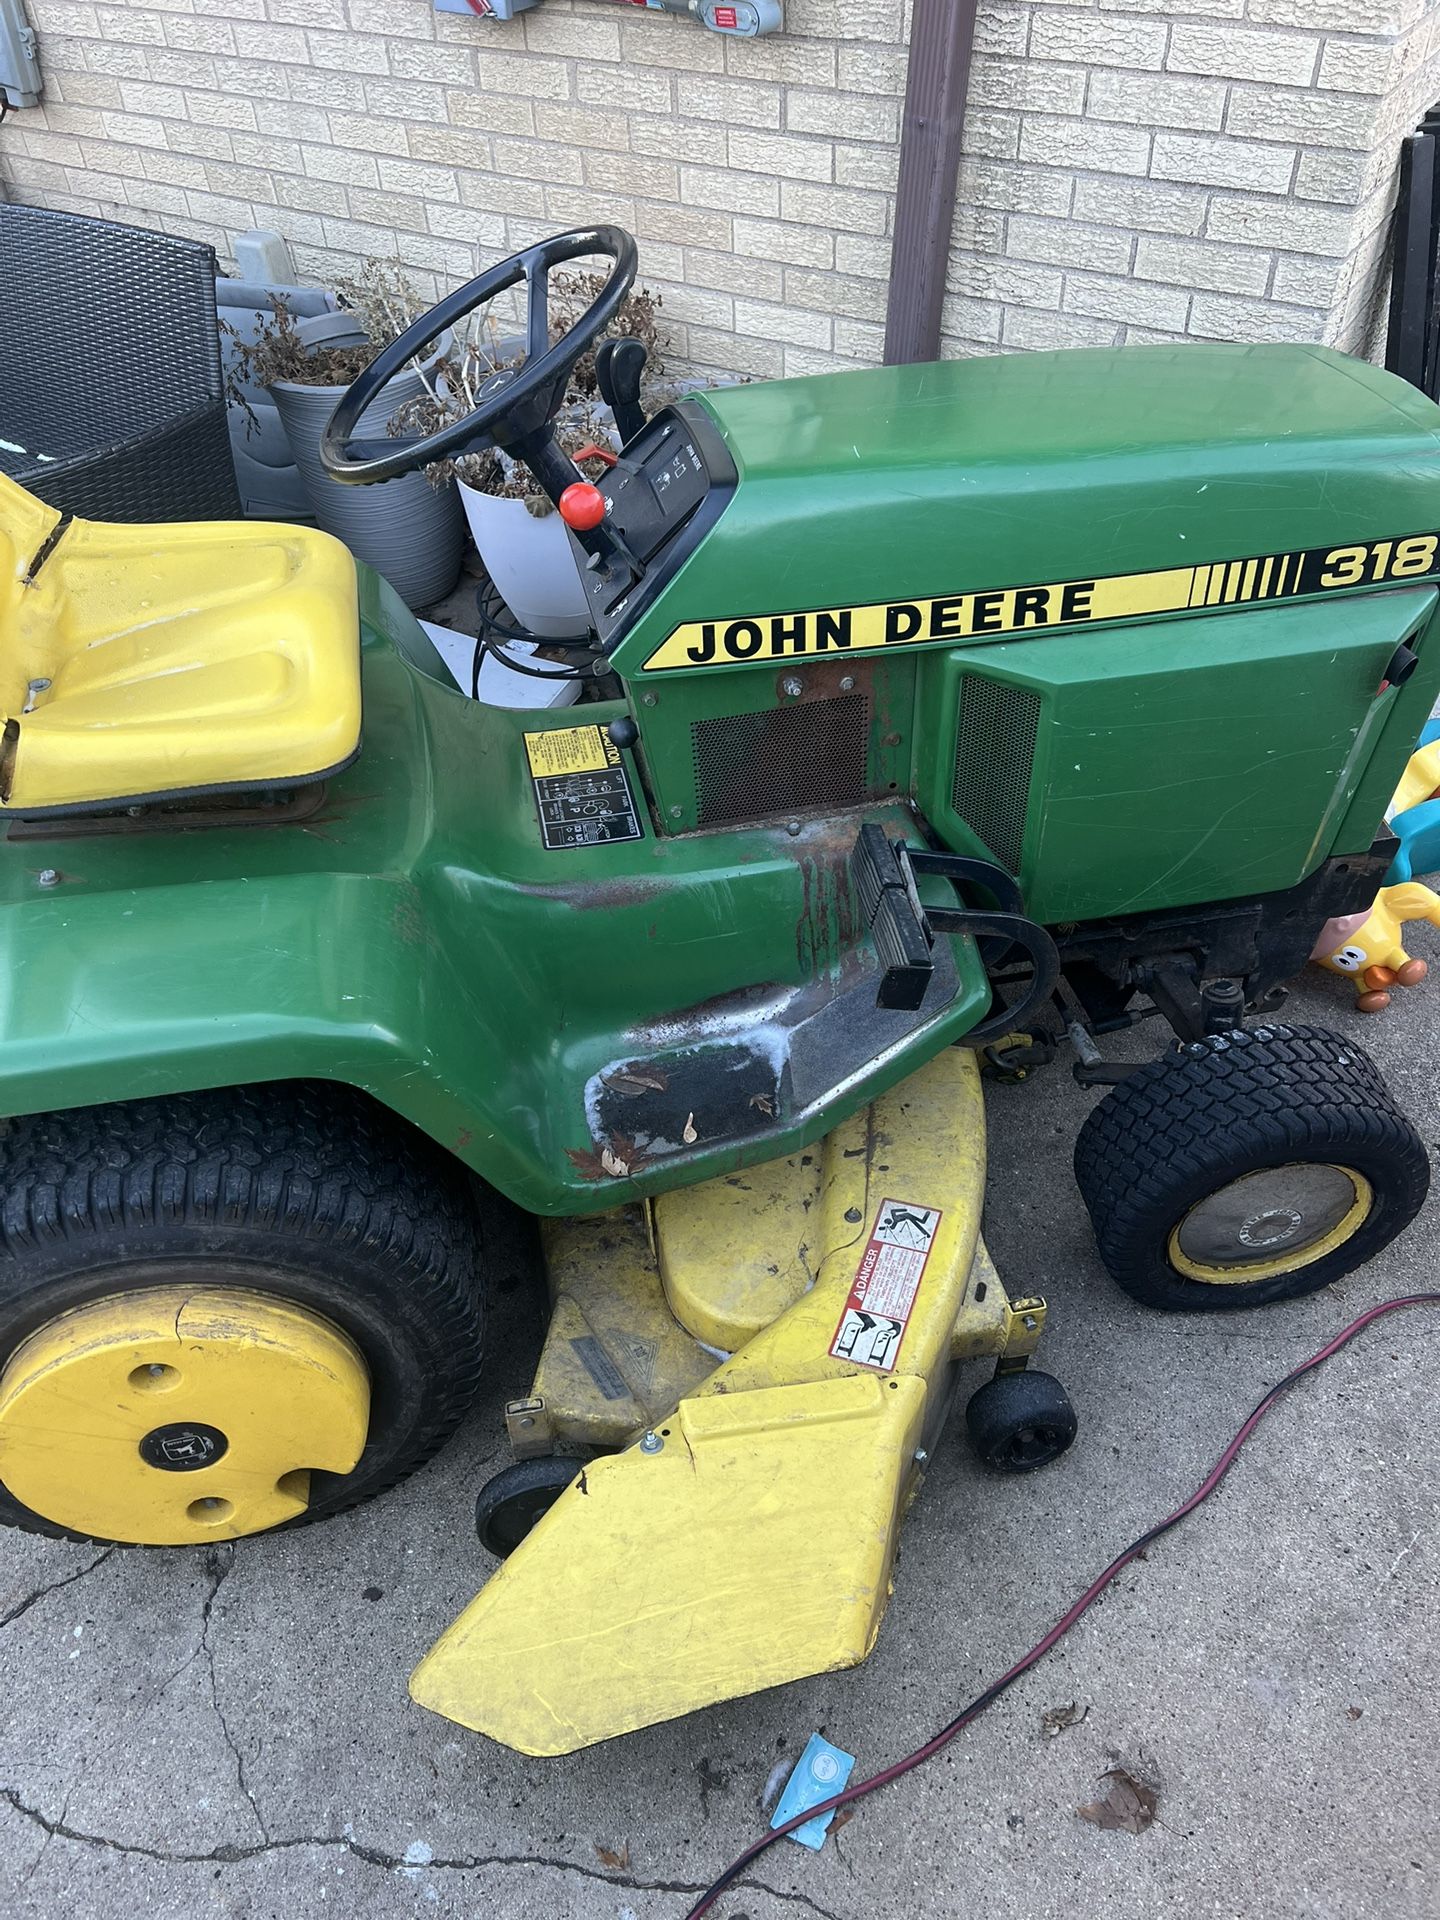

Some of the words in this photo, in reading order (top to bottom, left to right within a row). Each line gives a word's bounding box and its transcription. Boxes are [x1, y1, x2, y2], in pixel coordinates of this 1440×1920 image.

[1320, 535, 1438, 587] 318
[687, 610, 851, 663] JOHN
[885, 582, 1095, 642] DEERE
[602, 733, 622, 764] CAUTION
[615, 775, 623, 784] LIFT
[621, 795, 629, 807] PARK
[626, 815, 636, 834] BRAKES
[856, 1248, 878, 1290] DANGER
